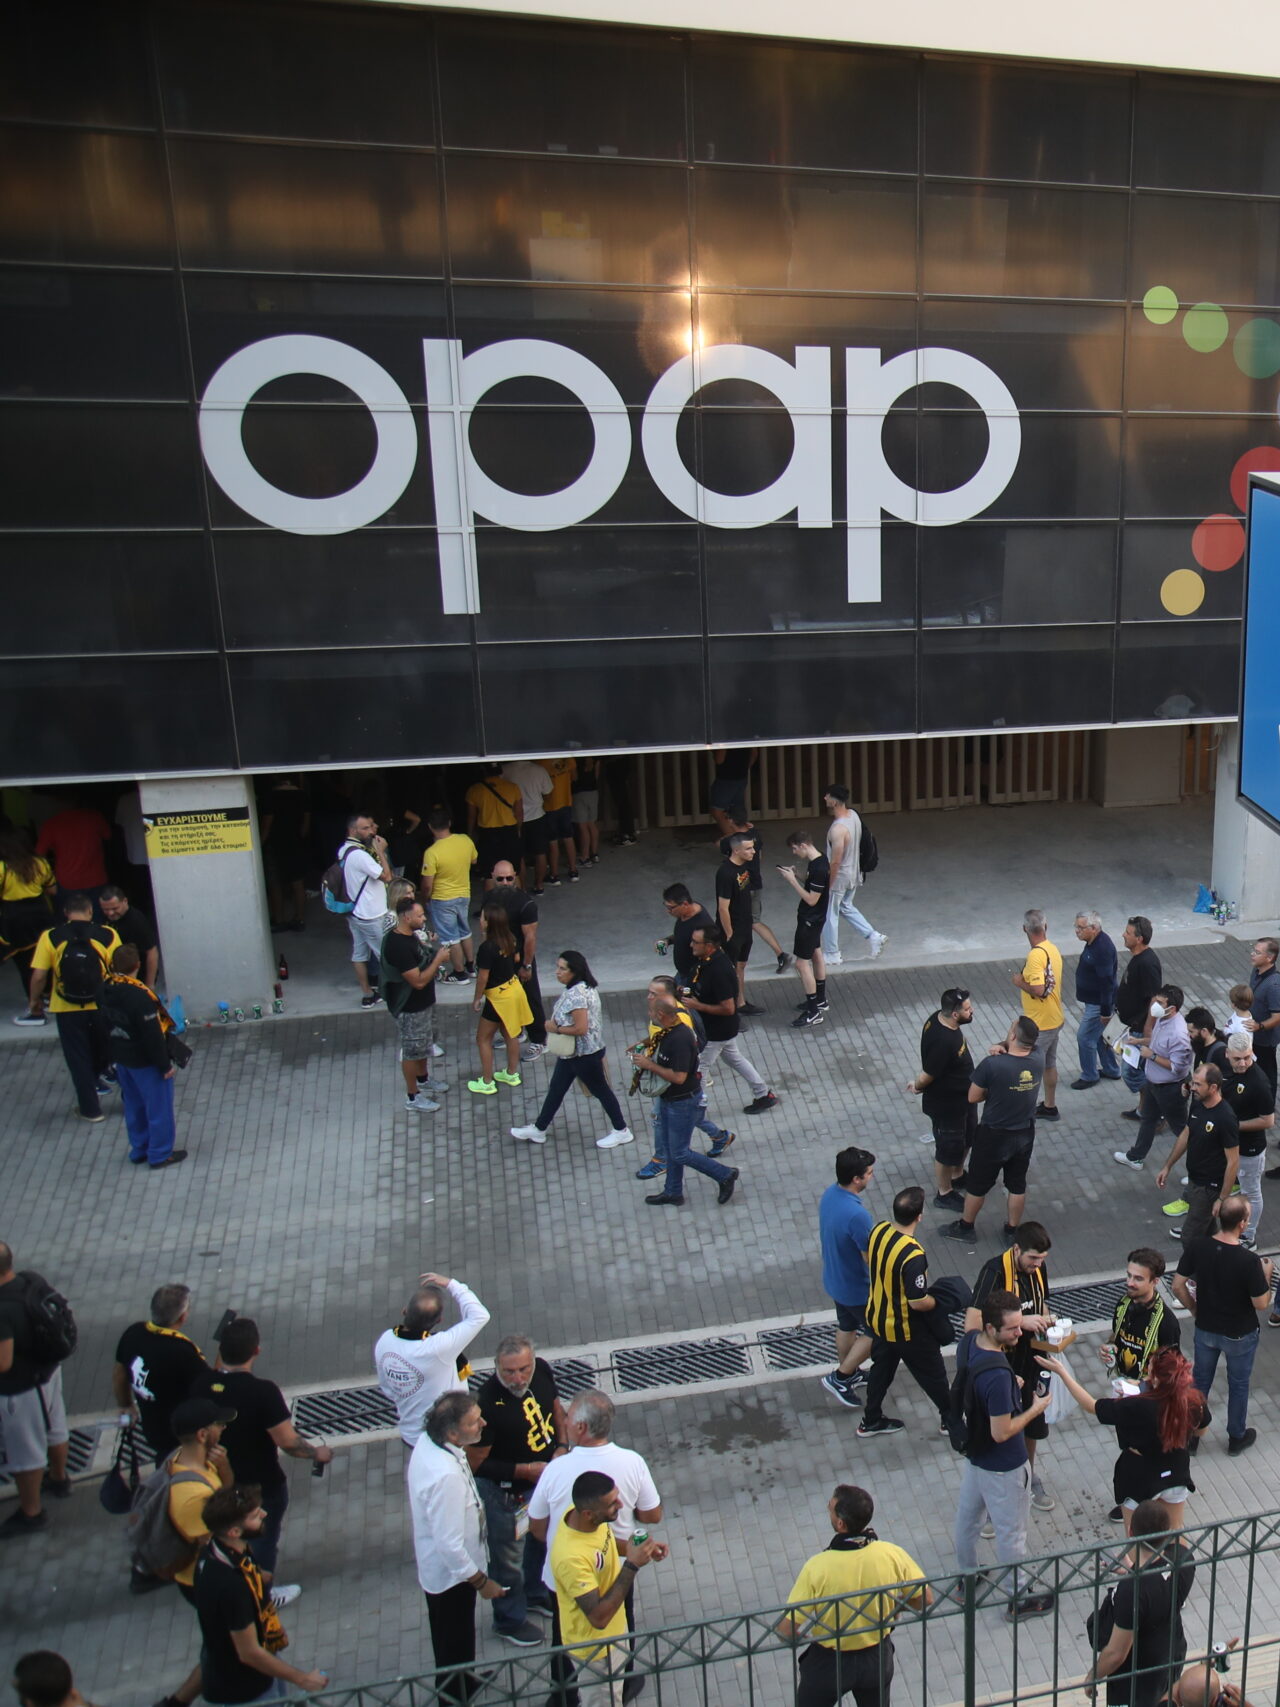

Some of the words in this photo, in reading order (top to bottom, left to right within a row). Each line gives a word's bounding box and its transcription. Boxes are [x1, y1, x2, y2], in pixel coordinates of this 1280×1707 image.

[200, 334, 1022, 615] opap
[157, 812, 227, 825] ΕΥΧΑΡΙΣΤΟΥΜΕ
[385, 1368, 410, 1382] VANS
